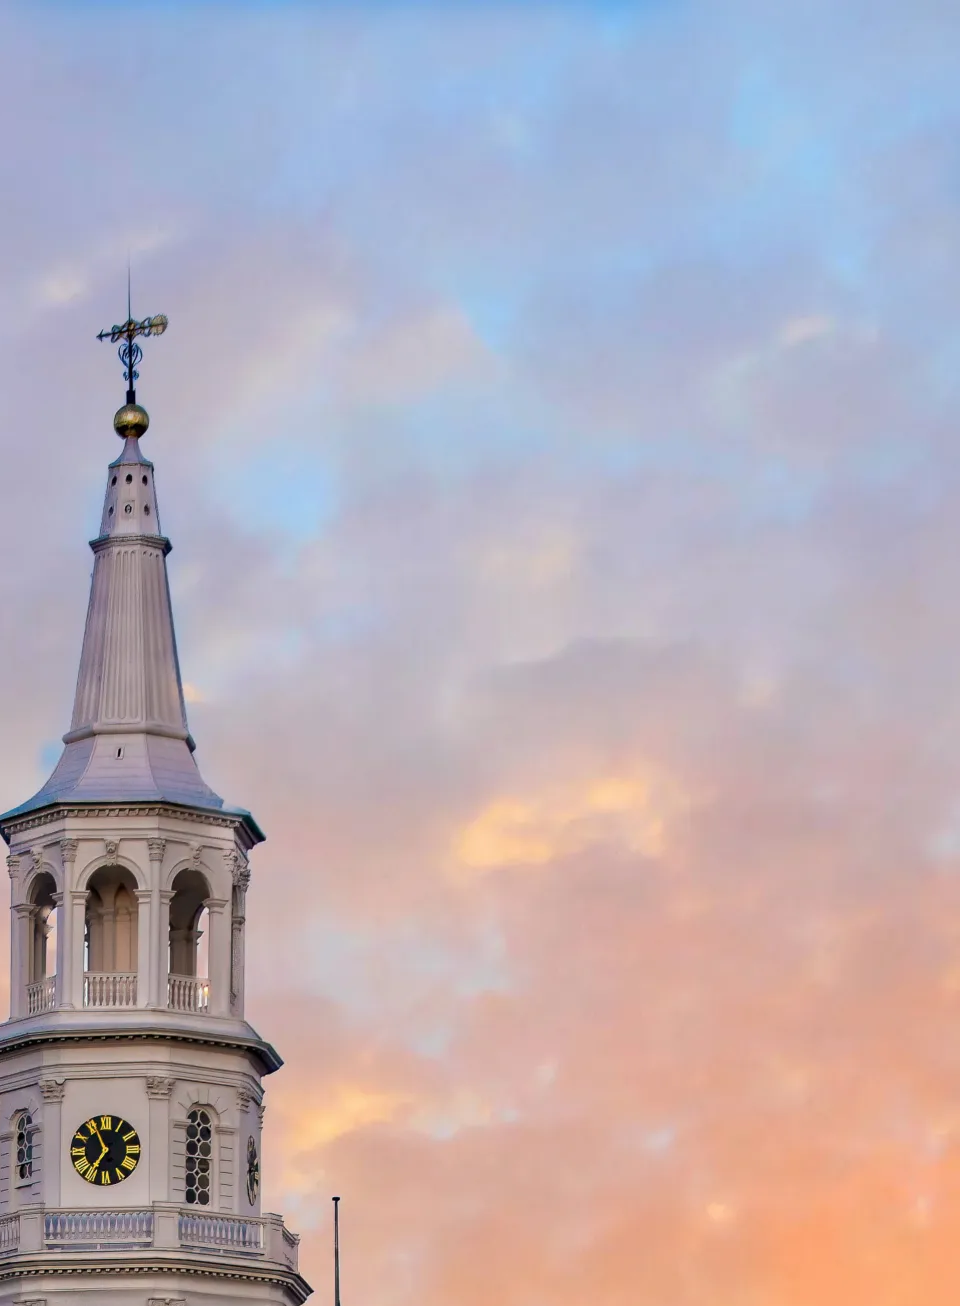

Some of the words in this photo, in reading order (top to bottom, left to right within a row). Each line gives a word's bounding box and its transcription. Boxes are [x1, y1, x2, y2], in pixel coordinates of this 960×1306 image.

[100, 1116, 112, 1130] XII
[115, 1120, 124, 1132] I
[75, 1132, 88, 1143] X
[122, 1130, 137, 1142] II
[126, 1145, 140, 1154] III
[102, 1171, 110, 1184] VI
[115, 1168, 125, 1180] V
